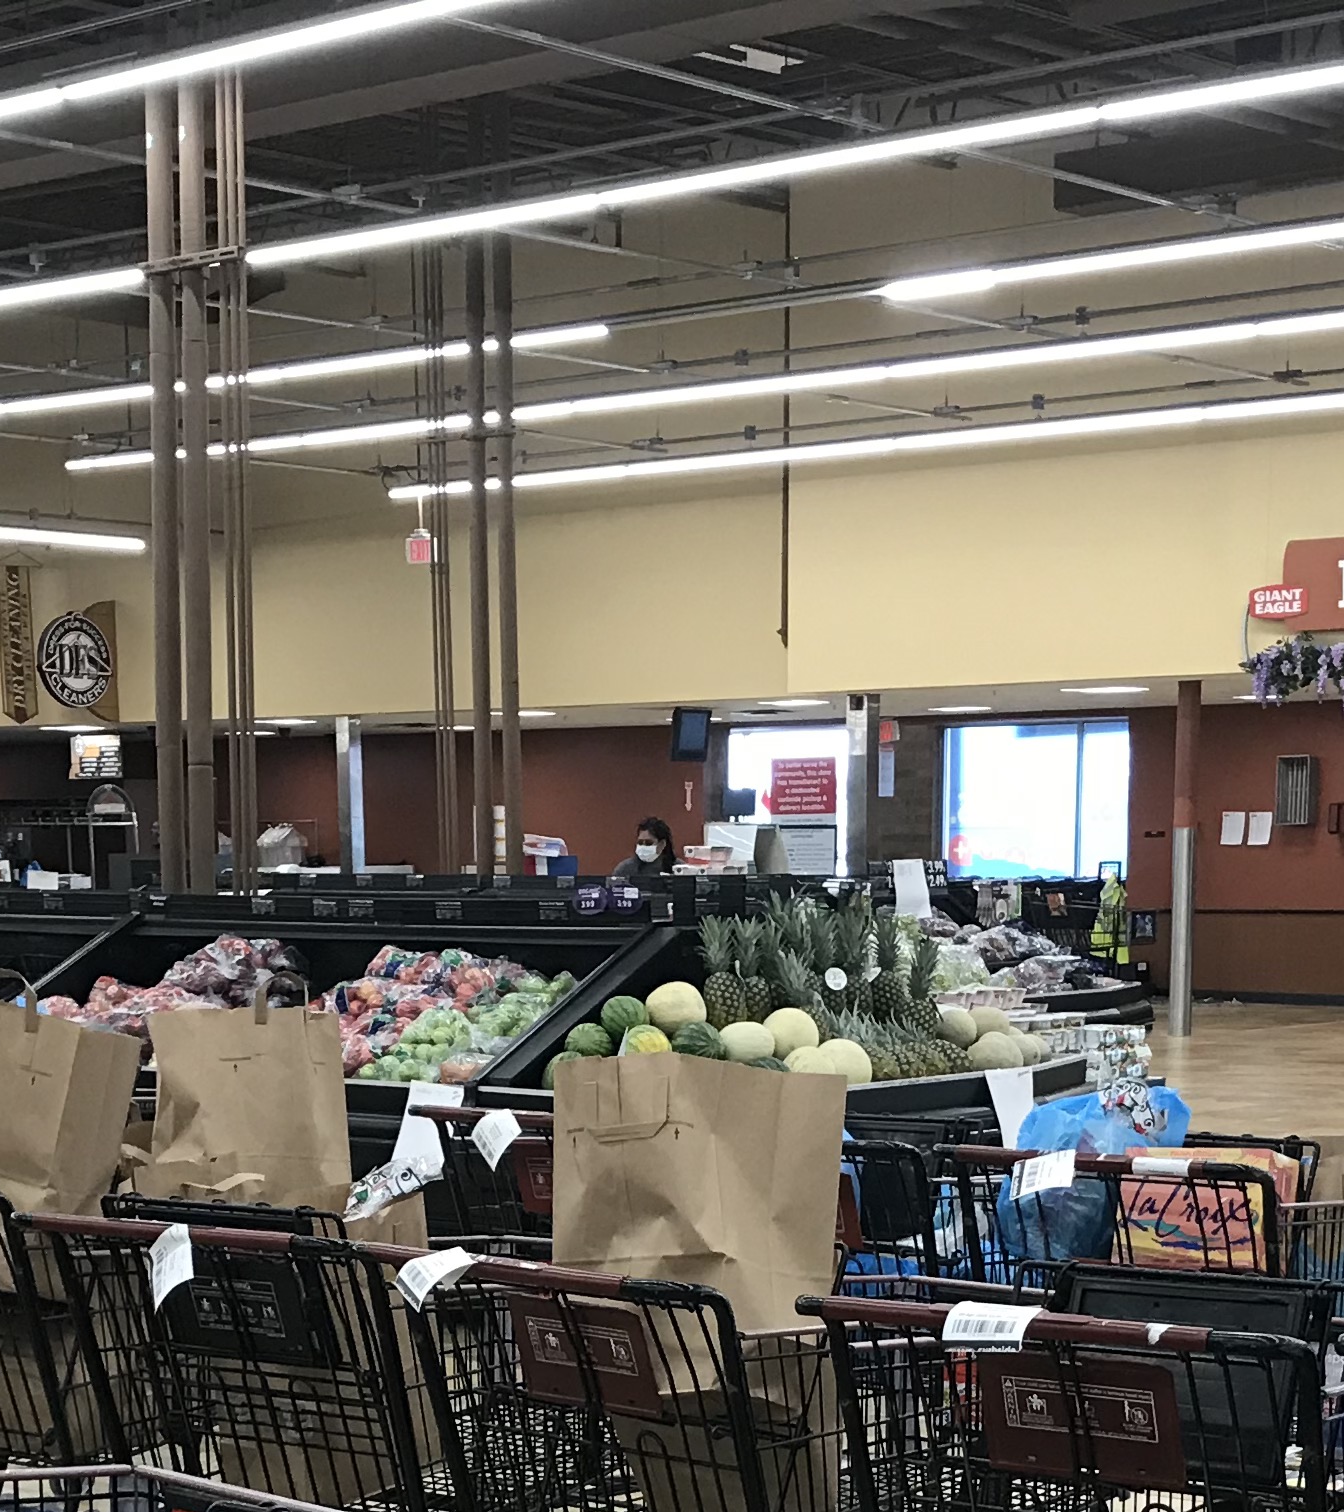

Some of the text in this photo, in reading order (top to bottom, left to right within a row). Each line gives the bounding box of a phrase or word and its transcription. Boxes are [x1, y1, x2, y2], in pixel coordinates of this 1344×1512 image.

[1254, 588, 1303, 602] GIANT
[1255, 601, 1301, 614] EAGLE
[7, 571, 27, 708] DRY CLEANING
[51, 673, 106, 703] CLEANERS
